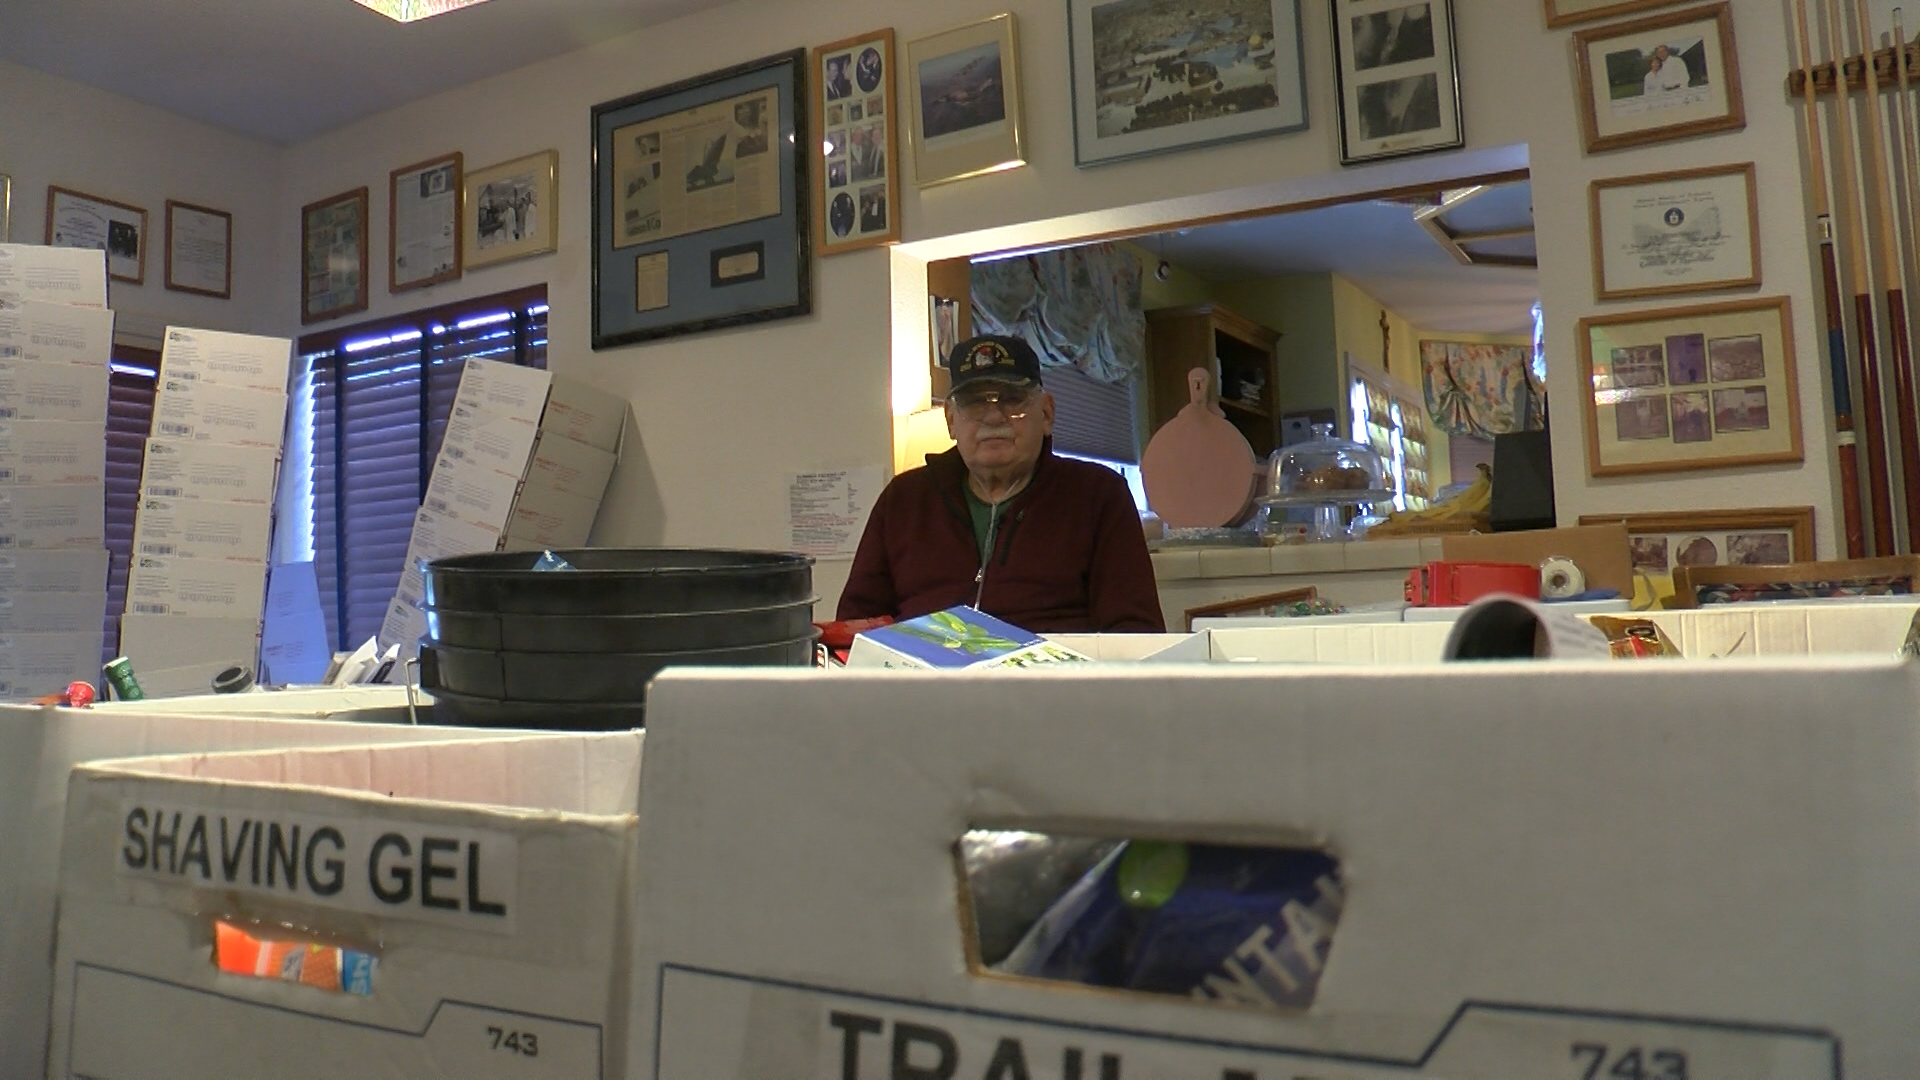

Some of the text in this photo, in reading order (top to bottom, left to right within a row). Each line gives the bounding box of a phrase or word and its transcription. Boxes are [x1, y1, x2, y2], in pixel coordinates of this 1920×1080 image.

[123, 807, 507, 917] SHAVING GEL
[487, 1026, 539, 1057] 743
[830, 1011, 1121, 1080] TRA
[1570, 1043, 1690, 1080] 743
